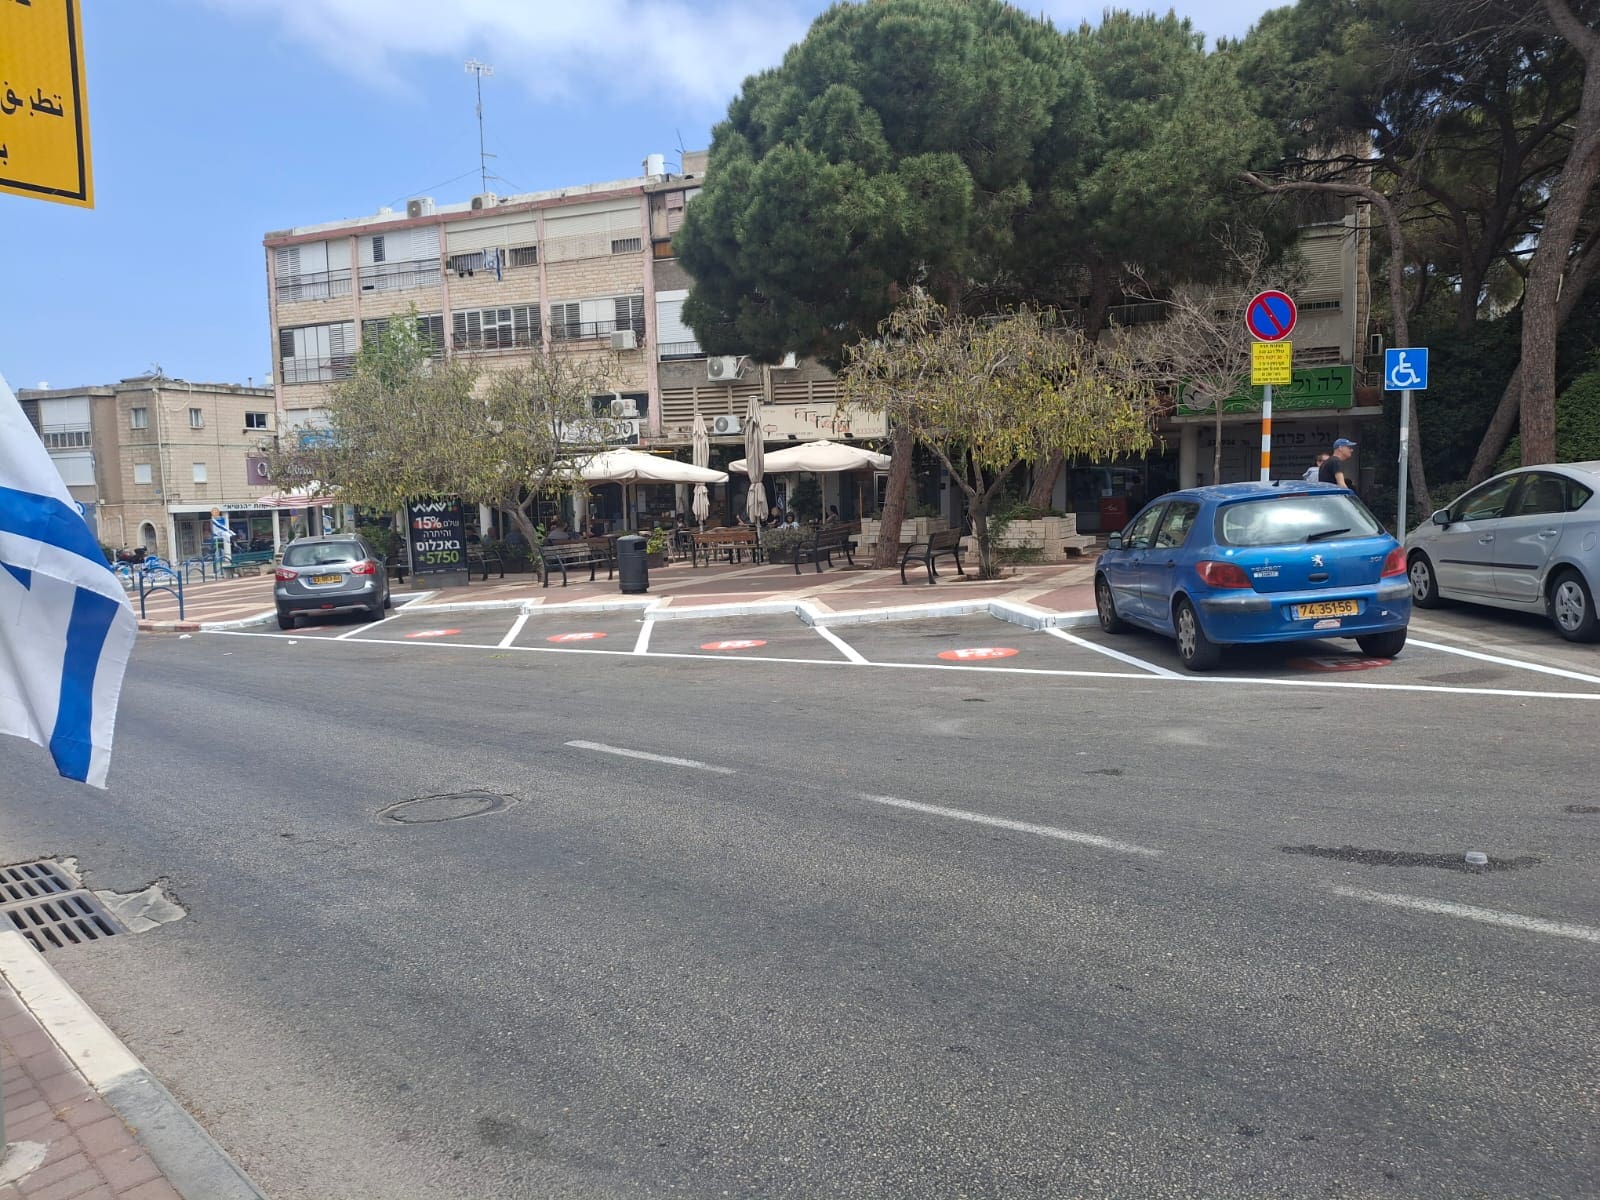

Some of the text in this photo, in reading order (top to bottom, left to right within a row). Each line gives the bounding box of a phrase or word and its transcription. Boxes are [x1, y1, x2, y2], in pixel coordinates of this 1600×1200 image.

[1317, 369, 1344, 391] לה
[415, 515, 460, 529] שלם 15%
[423, 530, 452, 538] והיתרה
[416, 539, 461, 551] באכלוס
